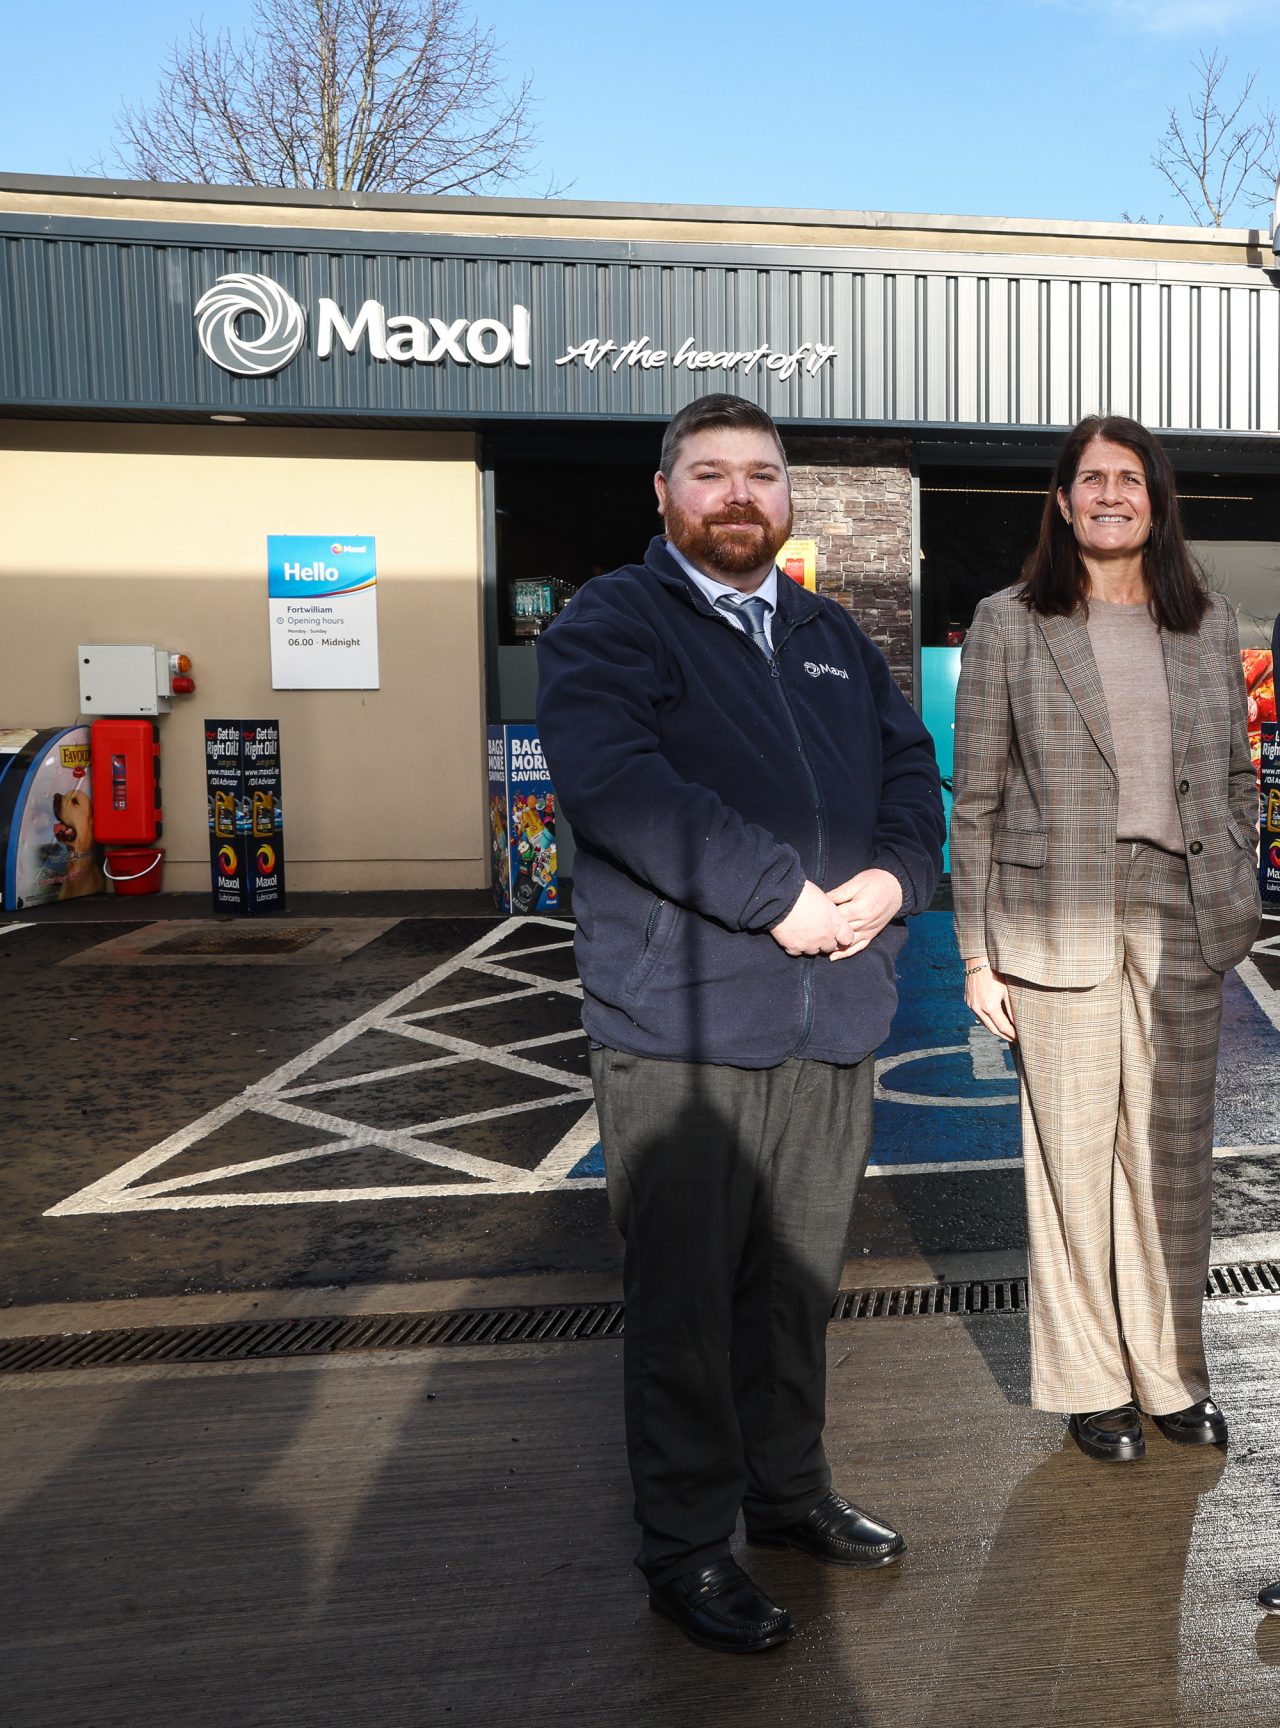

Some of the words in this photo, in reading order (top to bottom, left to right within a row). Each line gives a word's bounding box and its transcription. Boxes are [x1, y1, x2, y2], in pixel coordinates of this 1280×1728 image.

[316, 297, 531, 368] Maxol
[555, 338, 617, 371] At
[612, 335, 667, 372] the
[673, 336, 772, 375] heart
[766, 342, 812, 381] of
[805, 342, 838, 377] it
[284, 562, 339, 582] Hello
[287, 605, 333, 614] Fortwilliam
[288, 616, 321, 627] Opening
[322, 616, 345, 625] hours
[288, 638, 314, 646] 06.00
[321, 637, 360, 648] Midnight
[818, 663, 850, 680] Maxol
[217, 727, 229, 740] Get
[229, 726, 240, 740] the
[256, 727, 267, 740] Get
[267, 726, 278, 740] the
[207, 740, 225, 760] Right
[225, 741, 239, 756] Oil!
[245, 740, 264, 760] Right
[264, 740, 277, 755] Oil!
[487, 739, 503, 755] BAGS
[511, 739, 543, 755] BAG
[63, 748, 91, 763] FAVOU
[488, 755, 504, 770] MORE
[488, 770, 505, 782] SAVINGS
[218, 875, 240, 889] Maxol
[256, 874, 277, 888] Maxol
[219, 892, 241, 903] Lubricants
[256, 892, 278, 902] Lubricants
